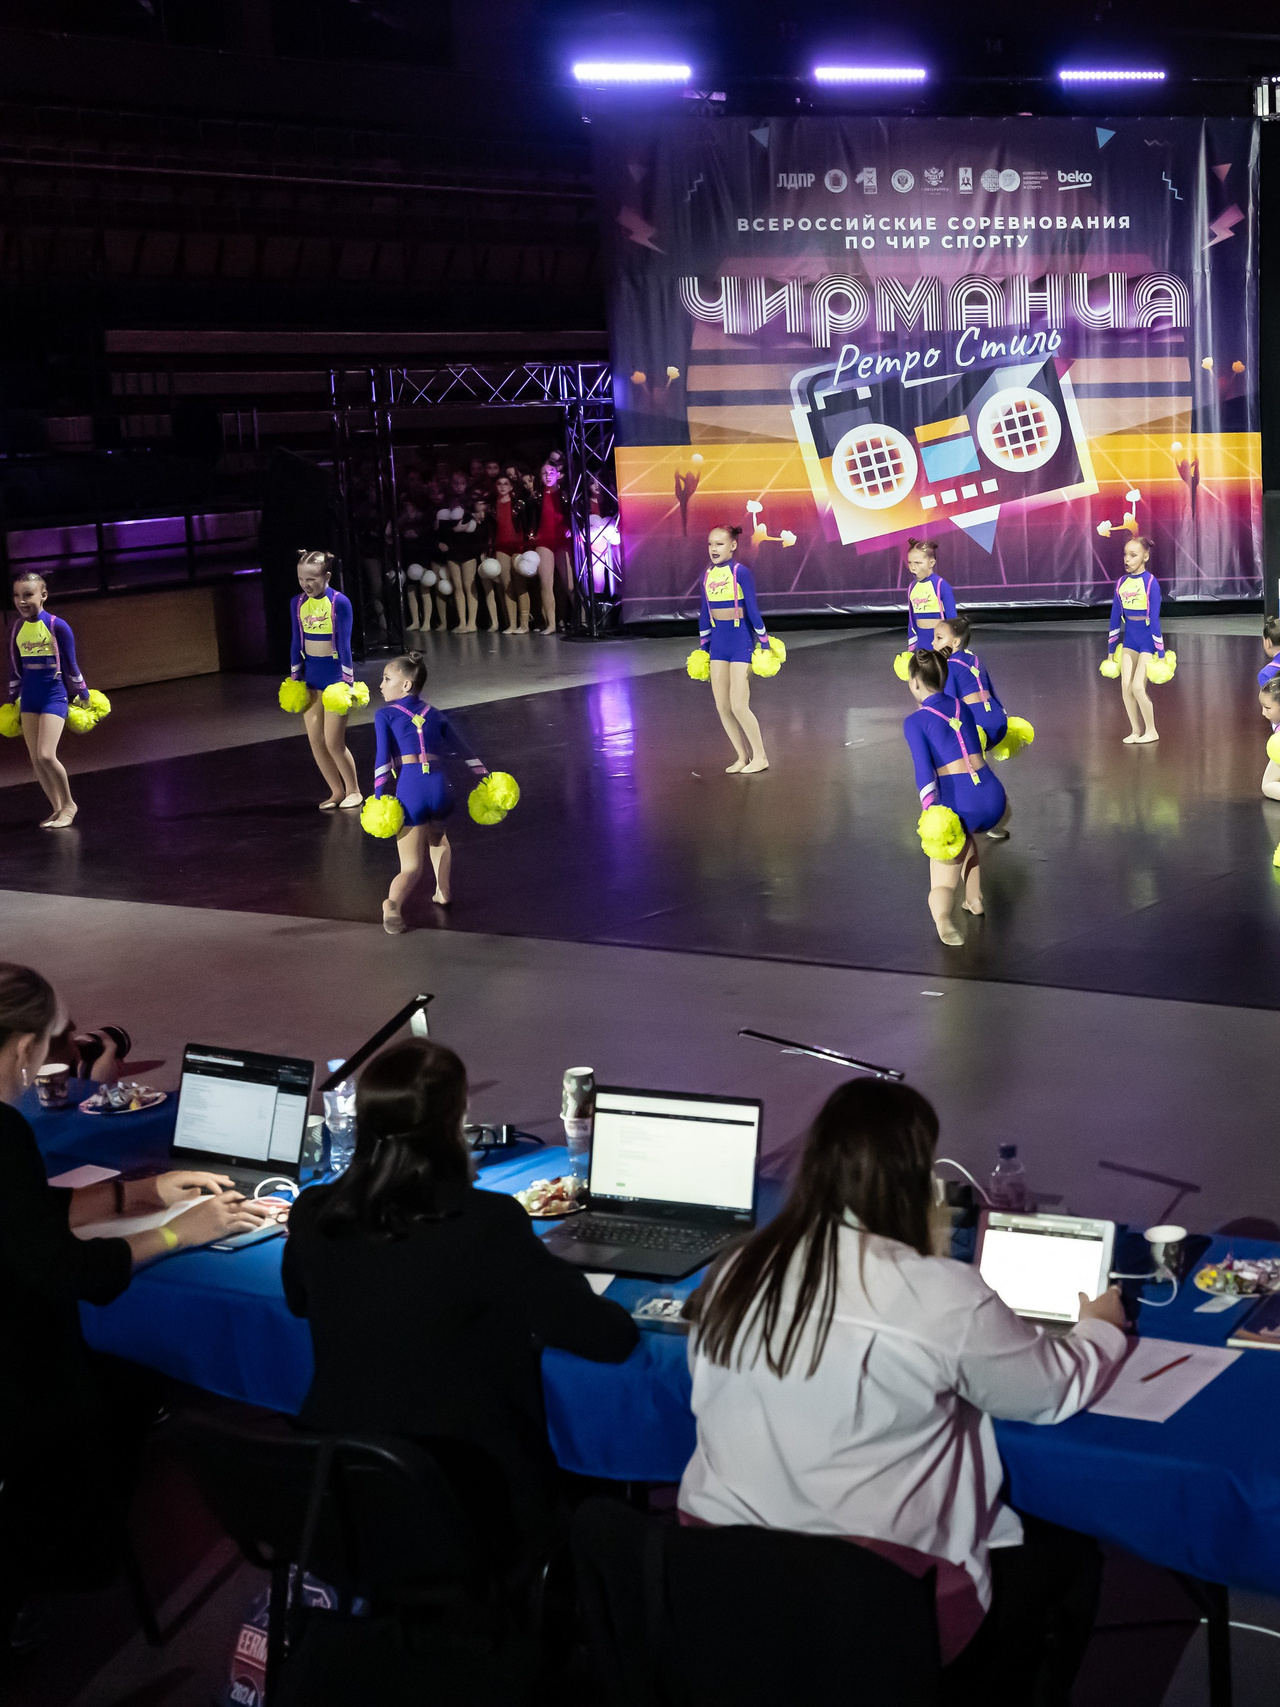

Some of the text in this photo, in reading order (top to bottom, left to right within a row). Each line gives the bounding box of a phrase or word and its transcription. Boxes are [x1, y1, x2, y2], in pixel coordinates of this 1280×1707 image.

[776, 173, 816, 190] ЛДПР
[1057, 169, 1093, 183] beko
[737, 214, 1131, 232] ВСЕРОССИЙСКИЕ СОРЕВНОВАНИЯ
[845, 234, 1029, 249] ПО ЧИР СПОРТУ
[833, 326, 1063, 387] Ретро Стиль
